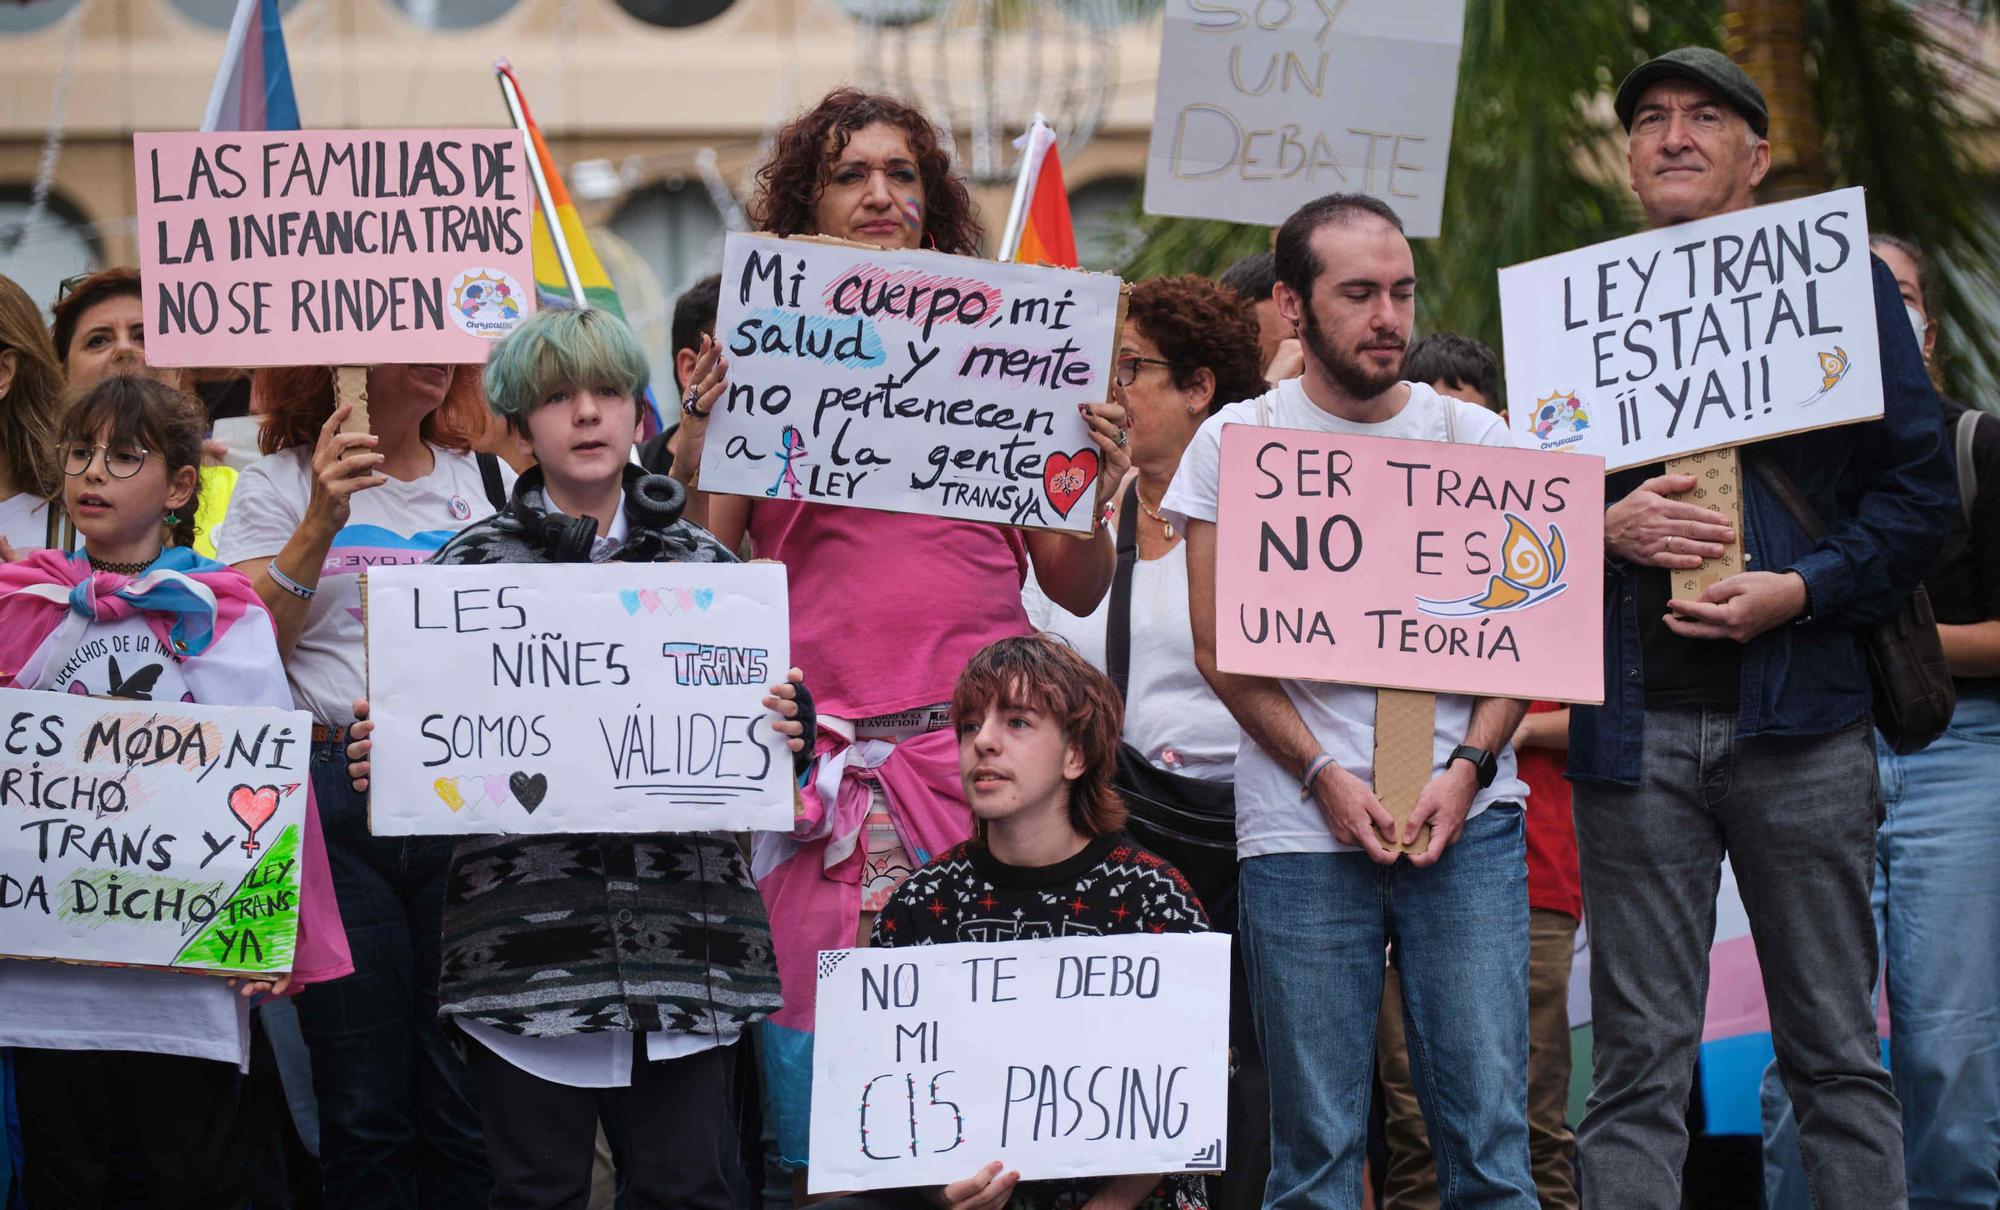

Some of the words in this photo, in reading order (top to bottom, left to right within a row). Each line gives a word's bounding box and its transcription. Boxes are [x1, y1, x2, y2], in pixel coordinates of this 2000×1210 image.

[1189, 0, 1346, 47] SOY
[1229, 47, 1330, 98] UN
[151, 144, 247, 203] LAS
[263, 141, 465, 198] FAMILIAS
[472, 141, 516, 200] DE
[1169, 102, 1430, 199] DEBATE
[158, 218, 214, 265] LA
[229, 209, 418, 262] INFANCIA
[420, 205, 523, 255] TRANS
[740, 250, 806, 307] Mi
[833, 275, 1003, 343] cuerpo,
[1010, 289, 1077, 329] mi
[1564, 250, 1662, 331] LEY
[1673, 211, 1850, 296] TRANS
[158, 280, 219, 335] NO
[227, 282, 273, 334] SE
[291, 277, 445, 333] RINDEN
[1593, 280, 1843, 388] ESTATAL
[729, 315, 876, 361] salud
[958, 337, 1090, 389] mente
[727, 382, 792, 416] no
[813, 374, 1054, 438] pertenecen
[725, 435, 767, 461] a
[831, 417, 892, 466] la
[910, 433, 1044, 490] gente
[809, 464, 868, 499] LEY
[1255, 441, 1353, 500] SER
[1386, 460, 1570, 513] TRANS
[1258, 514, 1363, 572] NO
[1416, 531, 1492, 575] ES
[414, 586, 527, 633] LES
[1240, 603, 1336, 646] UNA
[1364, 618, 1521, 663] TEORÍA
[112, 635, 130, 653] DE
[136, 635, 150, 653] LA
[492, 632, 630, 688] NIÑES
[662, 642, 769, 686] TRANS
[4, 712, 64, 757] ES
[421, 714, 551, 767] SOMOS
[599, 703, 771, 781] VÁLIDES
[20, 818, 177, 871] TRANS
[200, 829, 236, 869] Y
[246, 858, 296, 889] LEY
[0, 872, 51, 914] DA
[71, 875, 216, 923] DICHO
[222, 890, 296, 925] TRANS
[215, 928, 263, 964] YA
[861, 962, 919, 1011] NO
[961, 956, 1018, 1003] TE
[1055, 955, 1161, 999] DEBO
[895, 1021, 938, 1063] MI
[858, 1070, 966, 1160] CIS
[1001, 1064, 1190, 1148] PASSING
